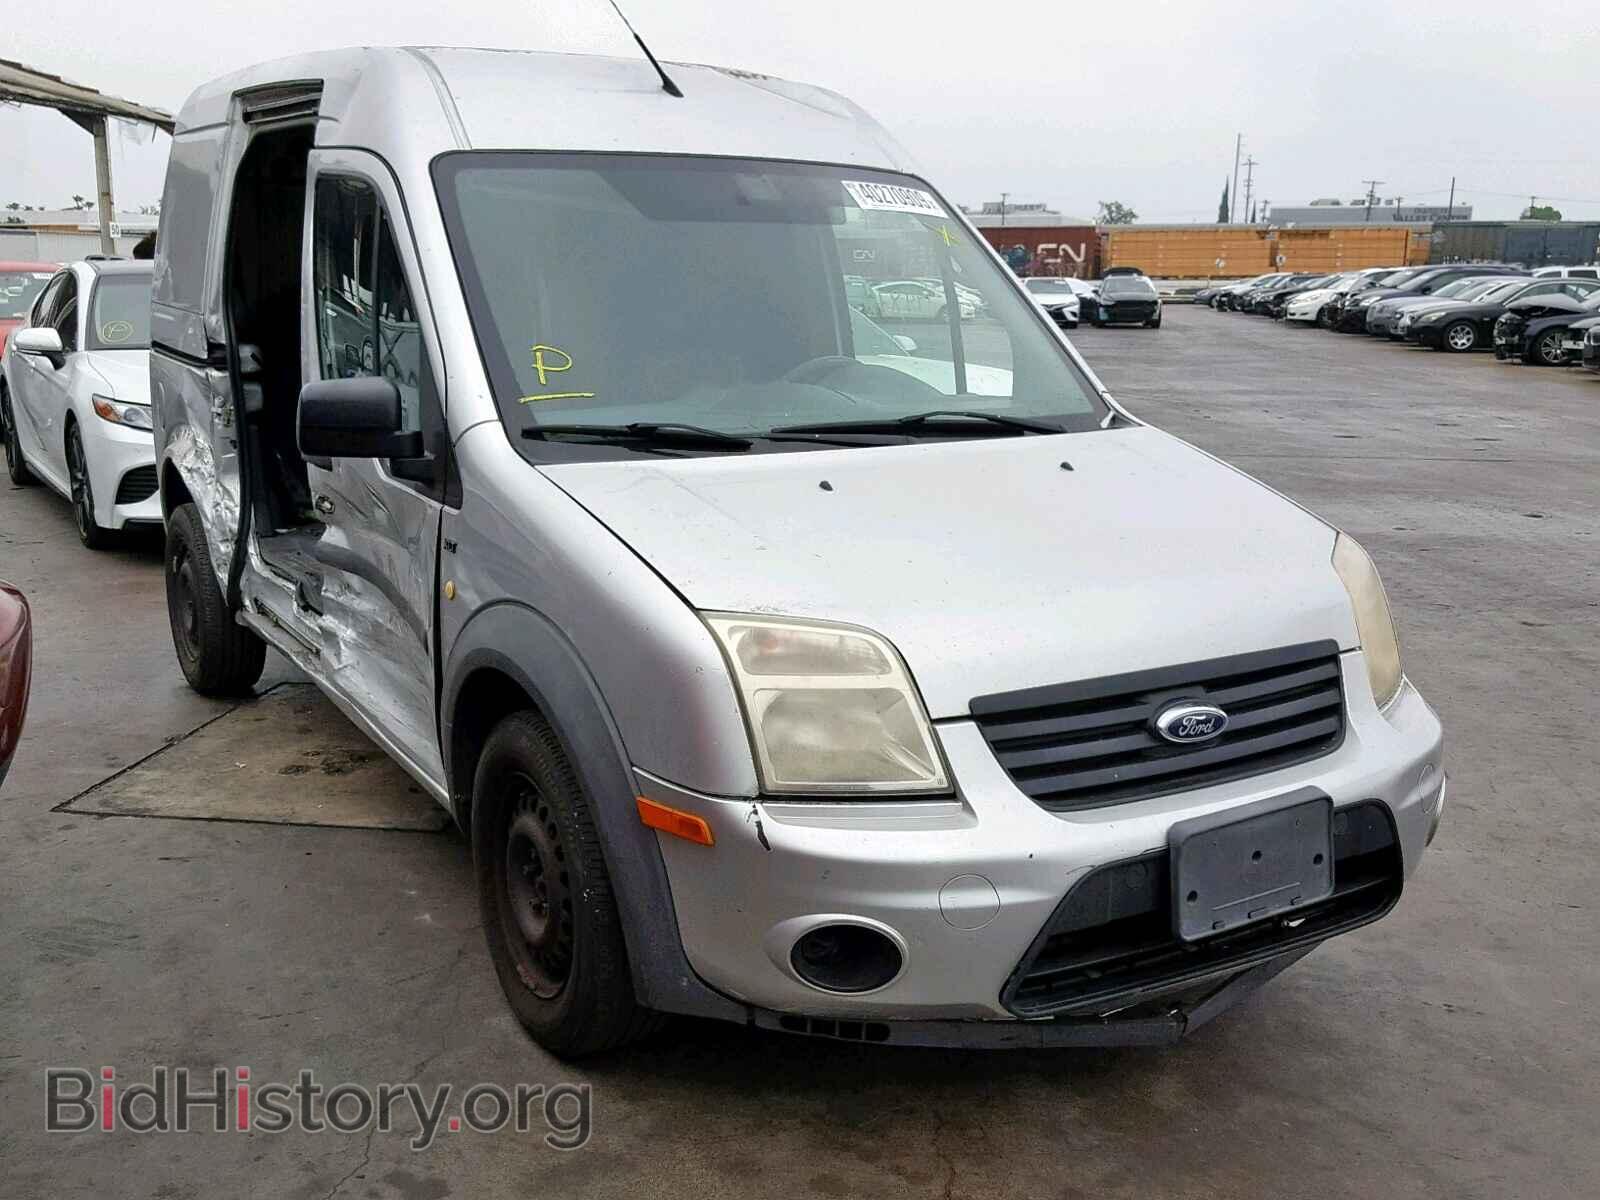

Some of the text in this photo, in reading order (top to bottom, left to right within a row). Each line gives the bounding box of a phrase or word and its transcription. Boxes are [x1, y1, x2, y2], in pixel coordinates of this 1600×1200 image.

[1037, 243, 1086, 263] CN
[530, 344, 573, 385] P
[1179, 715, 1216, 737] Ford
